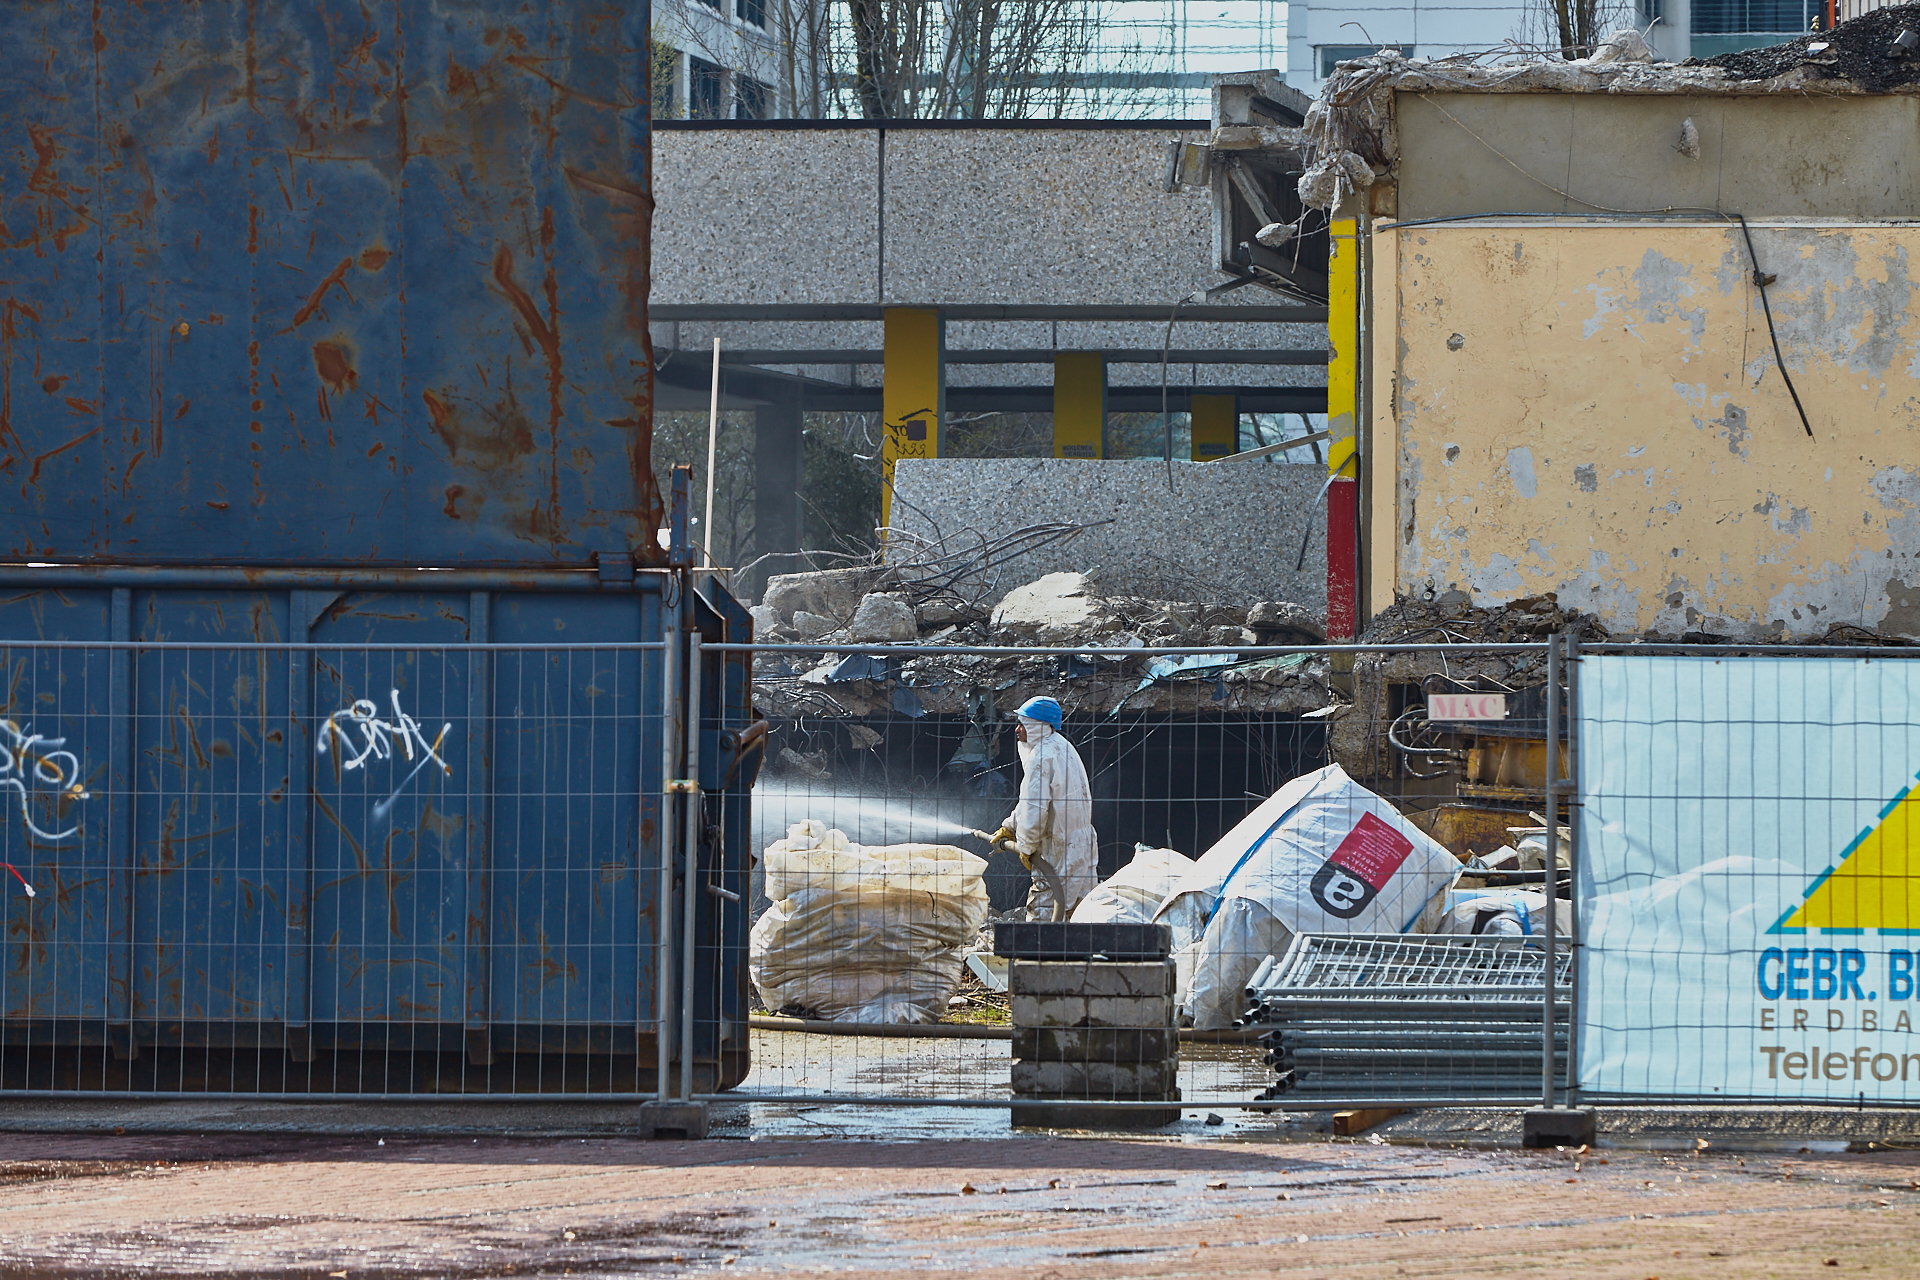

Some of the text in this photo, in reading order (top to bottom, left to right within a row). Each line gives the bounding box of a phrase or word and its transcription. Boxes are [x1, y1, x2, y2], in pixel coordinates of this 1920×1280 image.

[1433, 697, 1497, 718] MAC
[1340, 860, 1373, 882] ACHTUNG
[1758, 946, 1920, 1001] GEBR. B
[1760, 1008, 1913, 1033] ERDBA
[1759, 1046, 1920, 1081] Telefon
